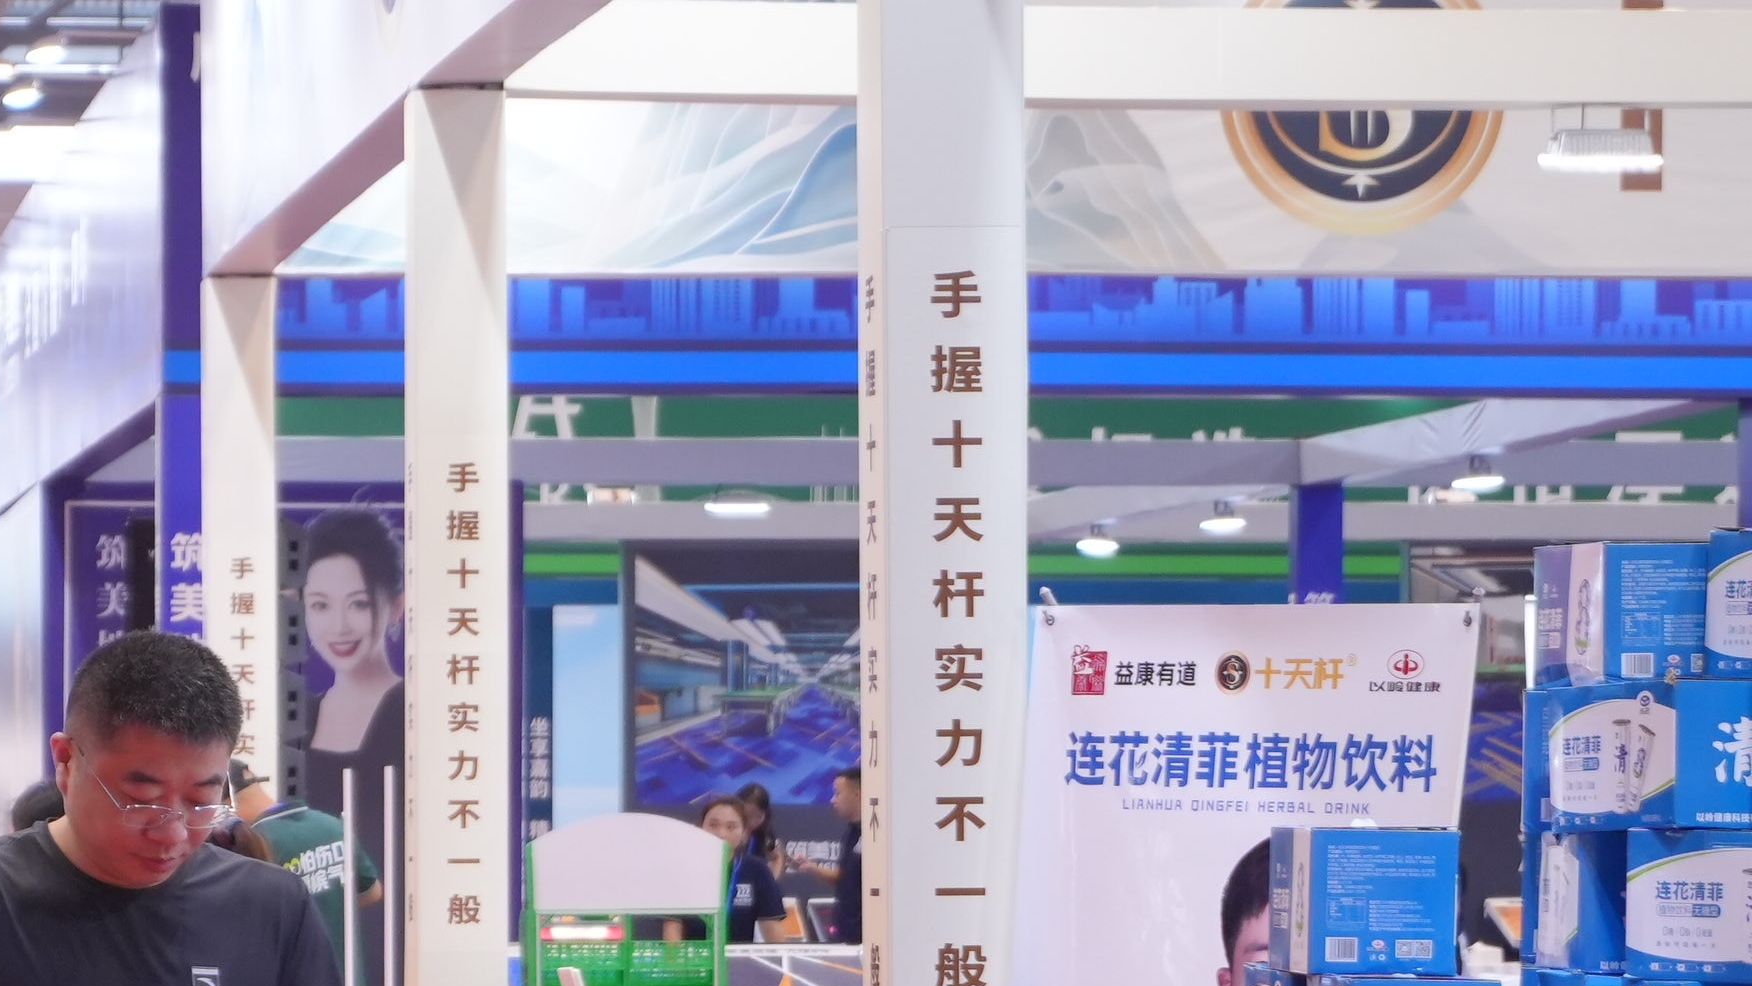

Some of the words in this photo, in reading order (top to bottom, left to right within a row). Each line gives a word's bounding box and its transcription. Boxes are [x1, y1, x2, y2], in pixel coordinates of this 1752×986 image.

[170, 532, 205, 643] 筑美
[1114, 660, 1197, 687] 益康有道
[1255, 657, 1345, 691] 十天杆
[446, 462, 482, 925] 手握十天杆实力不一般
[1064, 730, 1438, 793] 连花清菲植物饮料
[1122, 798, 1183, 812] LIANHUA
[1190, 799, 1249, 814] QINGFEI
[1257, 801, 1316, 815] HERBAL
[1324, 802, 1370, 816] DRINK
[1655, 880, 1724, 901] 连花清菲
